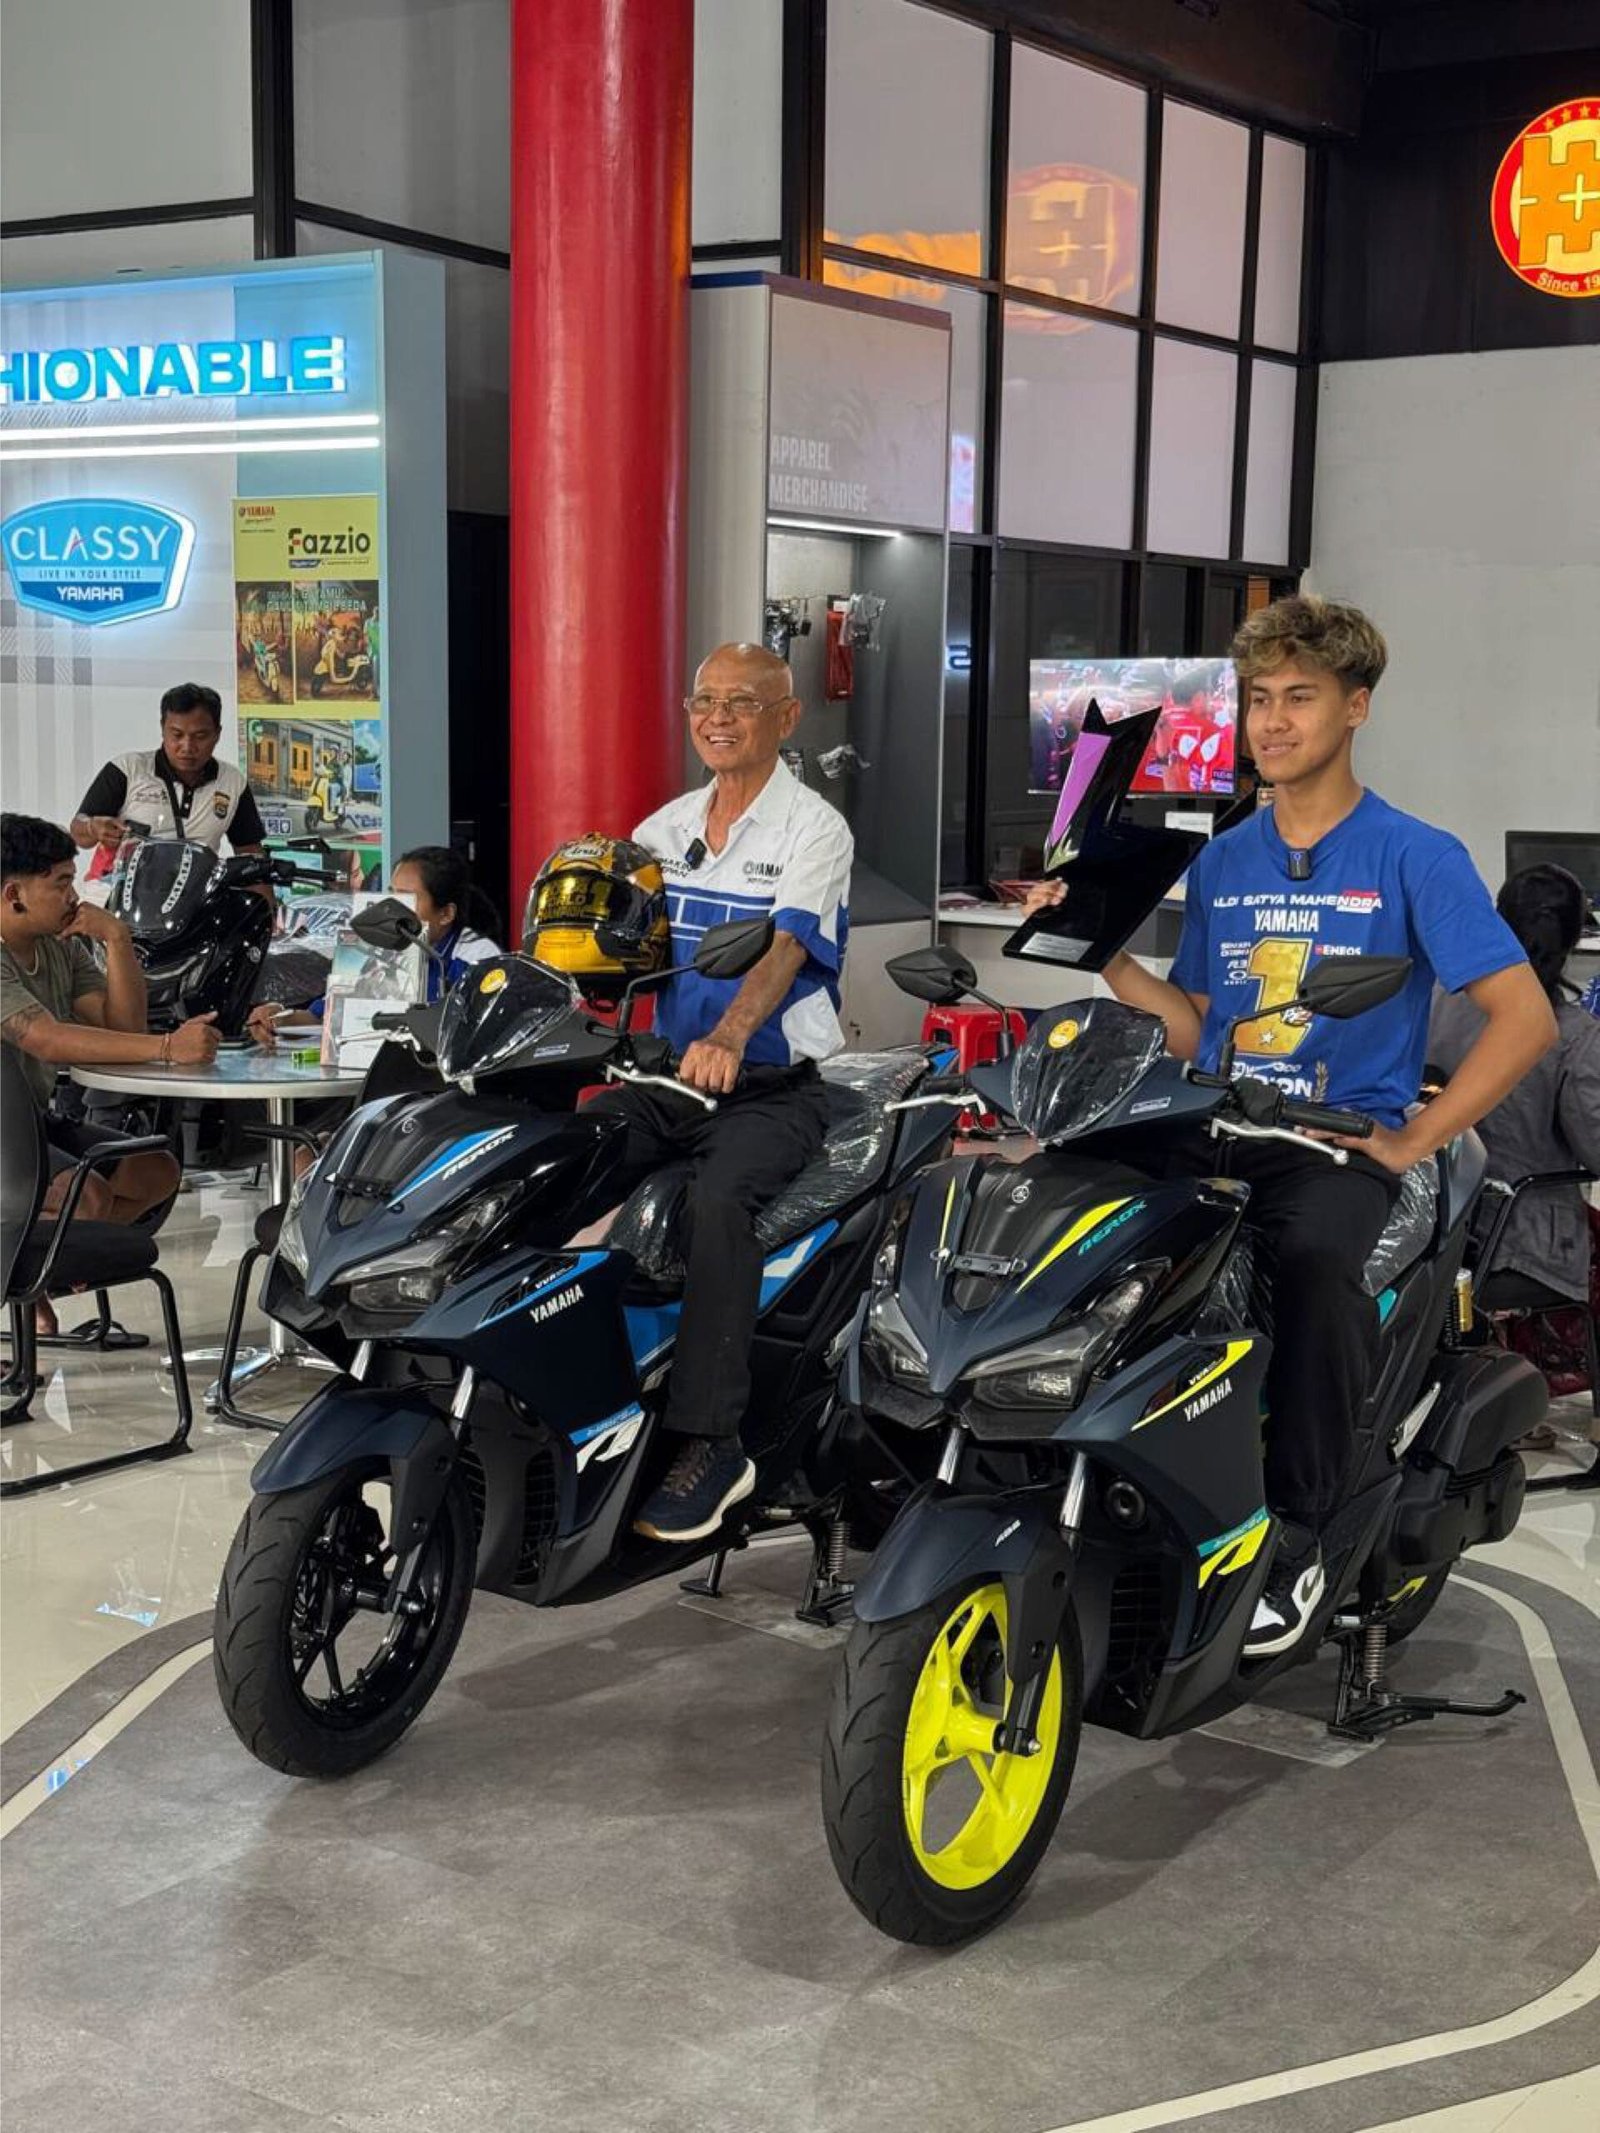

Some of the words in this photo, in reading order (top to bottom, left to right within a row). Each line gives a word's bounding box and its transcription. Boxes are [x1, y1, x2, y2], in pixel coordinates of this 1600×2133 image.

[1537, 272, 1579, 292] Since
[771, 434, 831, 471] APPAREL
[770, 474, 867, 512] MERCHANDISE
[10, 525, 170, 562] CLASSY
[39, 569, 60, 580] LIVE
[65, 569, 76, 580] IN
[81, 569, 107, 580] YOUR
[112, 569, 142, 580] STYLE
[56, 585, 124, 601] YAMAHA
[1243, 893, 1286, 907] SATYA
[1289, 893, 1383, 909] MAHENDRA
[1254, 908, 1320, 932] YAMAHA
[529, 1283, 585, 1324] YAMAHA
[1183, 1376, 1234, 1422] YAMAHA
